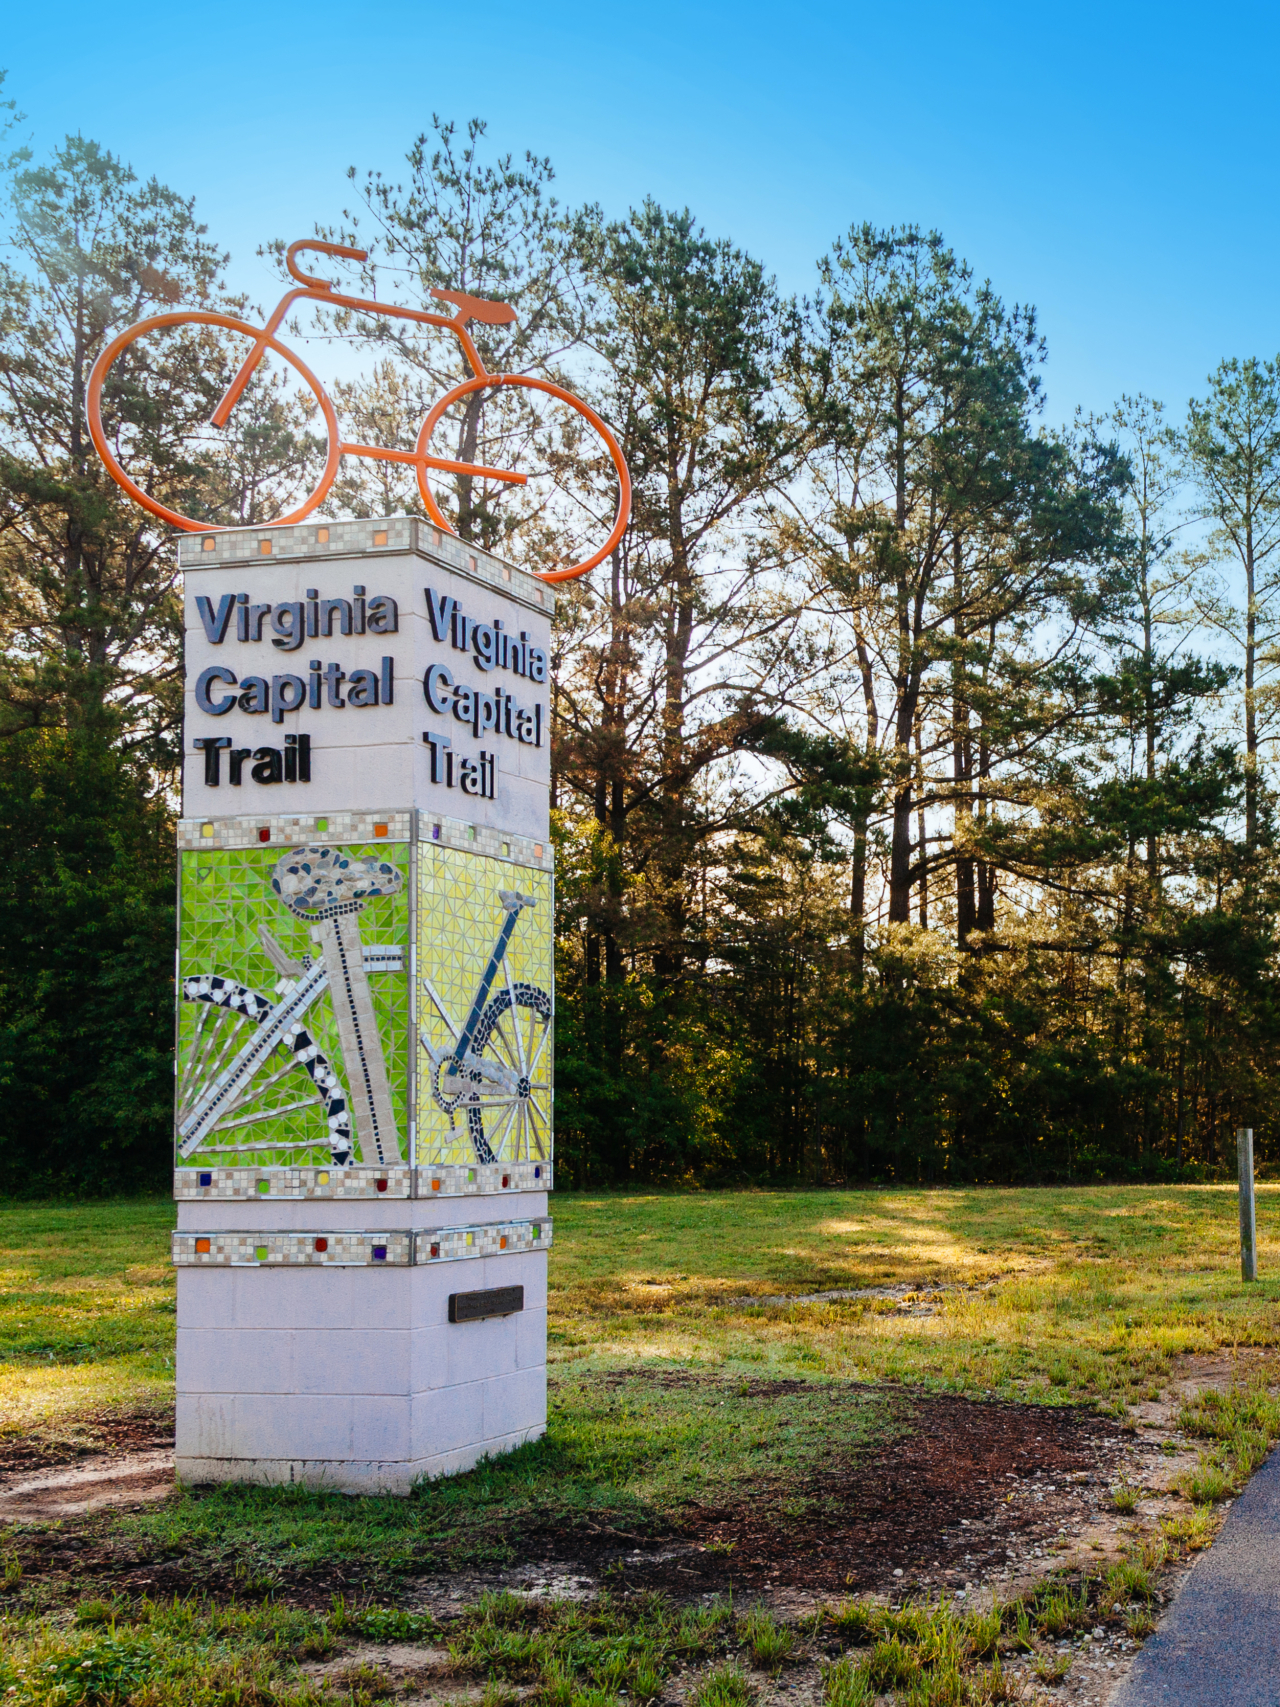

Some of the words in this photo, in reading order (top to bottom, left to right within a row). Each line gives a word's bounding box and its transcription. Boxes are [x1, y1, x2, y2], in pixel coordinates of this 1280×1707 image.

[194, 585, 399, 651] Virginia
[424, 587, 547, 683] Virginia
[194, 656, 394, 723] Capital
[423, 663, 545, 747] Capital
[193, 733, 311, 786] Trail
[423, 731, 499, 799] Trail
